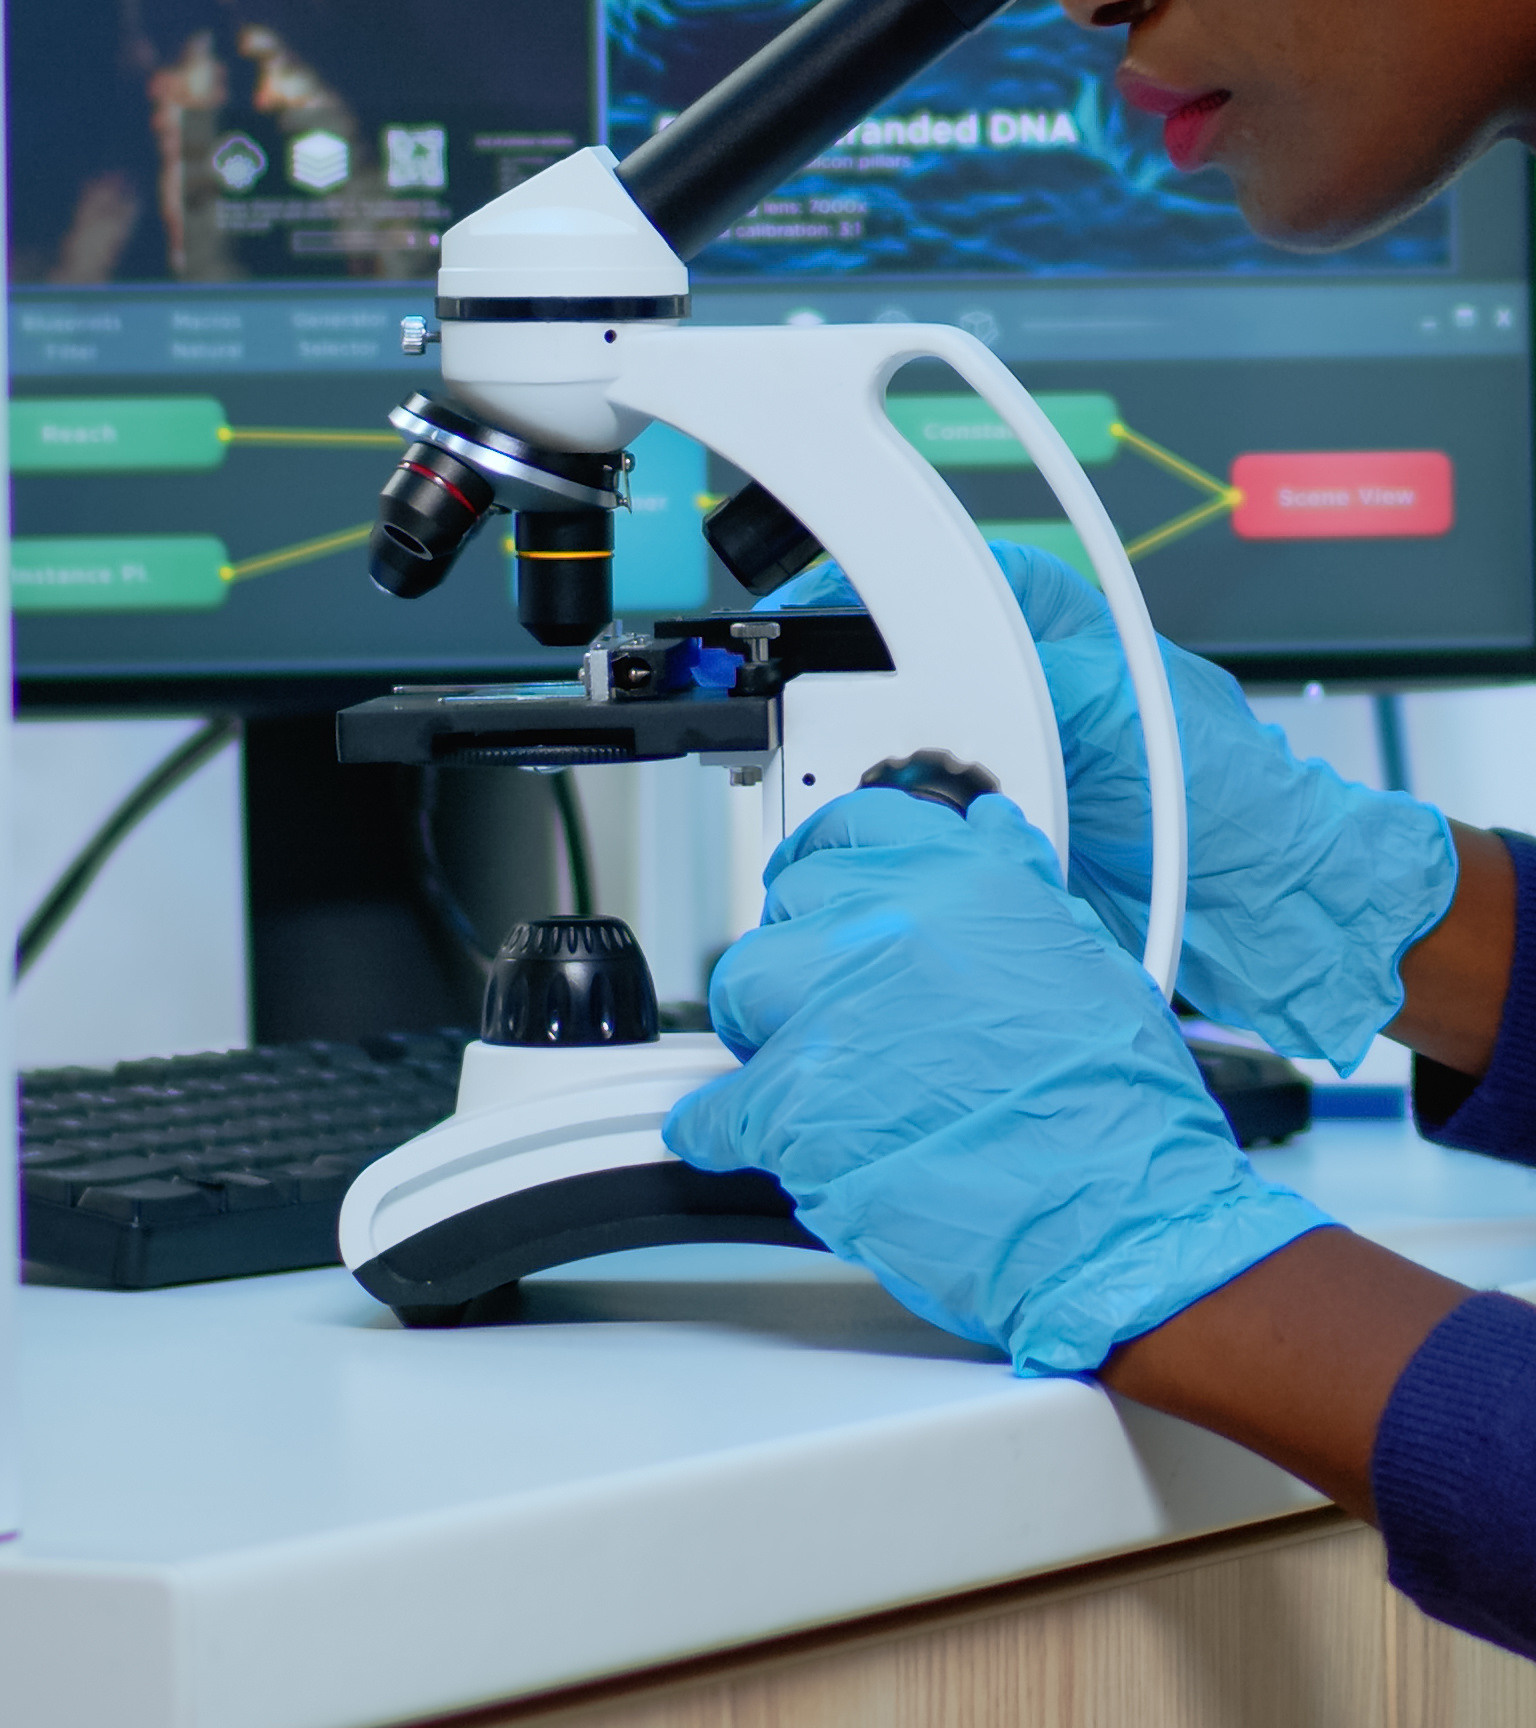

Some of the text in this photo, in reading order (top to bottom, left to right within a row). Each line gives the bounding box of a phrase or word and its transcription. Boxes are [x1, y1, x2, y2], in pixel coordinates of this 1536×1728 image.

[834, 113, 1078, 146] randed DNA
[858, 154, 912, 172] pillars
[764, 201, 803, 215] lens:
[810, 198, 867, 214] 7000x
[735, 223, 834, 239] calibration:
[292, 310, 389, 329] Generator
[298, 339, 381, 358] Selector
[40, 423, 118, 444] Reach
[923, 421, 1014, 441] Consta
[1278, 484, 1416, 508] Scene View
